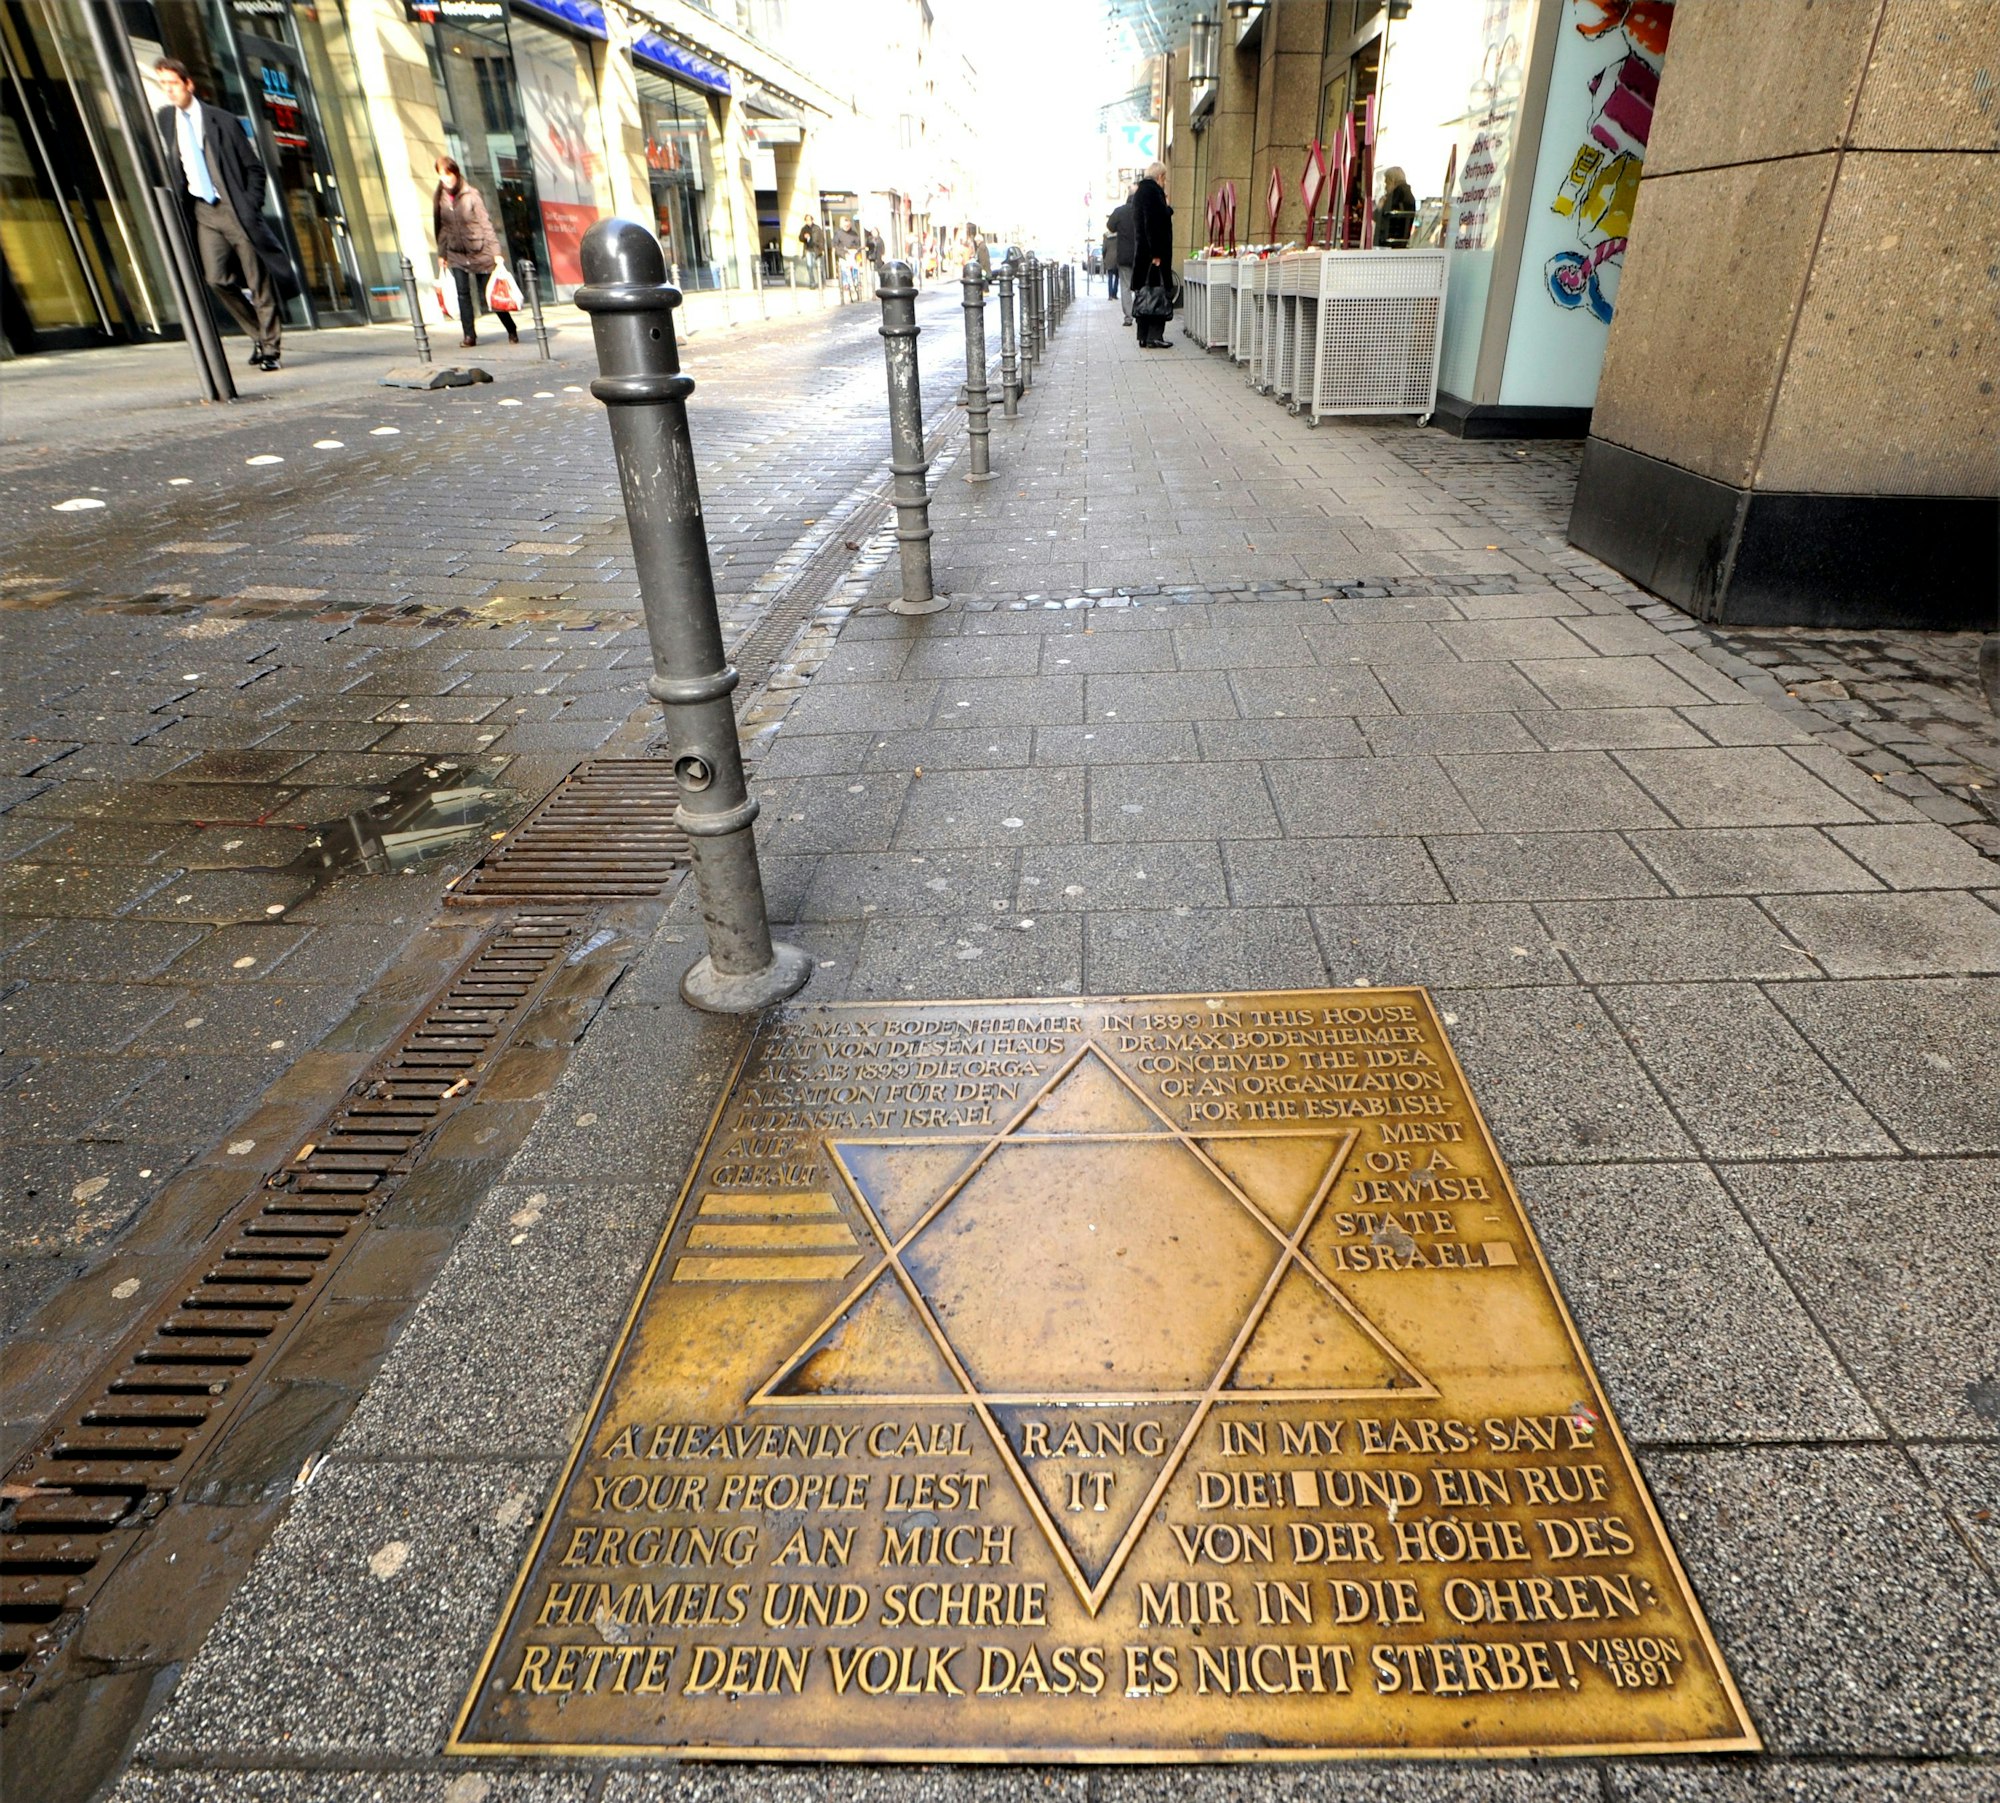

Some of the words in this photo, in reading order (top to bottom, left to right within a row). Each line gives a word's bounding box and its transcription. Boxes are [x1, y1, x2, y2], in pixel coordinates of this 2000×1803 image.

[883, 1016, 1082, 1037] BODENHEIMER
[1101, 1014, 1134, 1033] IN
[1140, 1013, 1203, 1031] 1899
[1209, 1011, 1243, 1029] IN
[1251, 1009, 1315, 1027] THIS
[1323, 1006, 1418, 1025] HOUSE
[760, 1040, 815, 1061] HAT
[822, 1040, 882, 1060] VON
[886, 1038, 986, 1059] DIESEM
[992, 1036, 1065, 1055] HAUS
[1231, 1026, 1426, 1050] BODENHEIMER
[808, 1063, 850, 1082] AB
[855, 1062, 909, 1081] 1899
[914, 1060, 960, 1080] DIE
[962, 1059, 1048, 1078] ORGA-
[1137, 1052, 1291, 1074] CONCEIVED
[1299, 1050, 1359, 1070] THE
[1364, 1048, 1437, 1068] IDEA
[743, 1085, 879, 1108] NISATION
[885, 1081, 946, 1104] FÜR
[953, 1081, 1019, 1101] DEN
[1160, 1078, 1196, 1098] OF
[1196, 1076, 1239, 1097] AN
[1242, 1070, 1446, 1096] ORGANIZATION
[730, 1108, 896, 1132] JUDENSTAAT
[901, 1104, 996, 1129] ISRAEL
[1188, 1101, 1243, 1122] FOR
[1245, 1099, 1300, 1121] THE
[1304, 1094, 1453, 1120] ESTABLISH-
[1379, 1121, 1464, 1144] MENT
[722, 1136, 807, 1159] AUF-
[1364, 1150, 1412, 1173] OF
[1427, 1149, 1459, 1171] A
[711, 1163, 818, 1187] GEBAUT
[1351, 1176, 1491, 1205] JEWISH
[1334, 1209, 1457, 1237] STATE
[1330, 1242, 1484, 1272] ISRAEL
[602, 1424, 639, 1460] A
[645, 1423, 862, 1460] HEAVENLY
[866, 1422, 974, 1458] CALL
[1021, 1421, 1168, 1459] RANG
[1219, 1420, 1267, 1456] IN
[1277, 1419, 1346, 1455] MY
[1356, 1418, 1479, 1454] EARS:
[1484, 1415, 1595, 1452] SAVE
[590, 1474, 708, 1513] YOUR
[715, 1473, 871, 1513] PEOPLE
[883, 1473, 990, 1512] LEST
[1065, 1471, 1116, 1511] IT
[1197, 1470, 1286, 1509] DIE!
[1322, 1469, 1424, 1508] UND
[1431, 1467, 1512, 1507] EIN
[1515, 1464, 1610, 1505] RUF
[558, 1526, 758, 1567] ERGING
[770, 1526, 858, 1567] AN
[878, 1525, 1017, 1567] MICH
[1169, 1523, 1275, 1567] VON
[1288, 1521, 1386, 1566] DER
[1391, 1515, 1532, 1563] HÖHE
[1535, 1516, 1635, 1560] DES
[535, 1583, 752, 1628] HIMMELS
[761, 1583, 870, 1628] UND
[880, 1582, 1048, 1627] SCHRIE
[1138, 1580, 1241, 1627] MIR
[1253, 1580, 1314, 1625] IN
[1327, 1578, 1426, 1624] DIE
[1443, 1574, 1659, 1623] OHREN:
[1577, 1637, 1684, 1664] VISION
[509, 1645, 676, 1695] RETTE
[681, 1645, 815, 1696] DEIN
[826, 1645, 967, 1697] VOLK
[974, 1642, 1107, 1697] DASS
[1124, 1645, 1181, 1697] ES
[1192, 1644, 1356, 1696] NICHT
[1370, 1640, 1582, 1694] STERBE!
[1608, 1659, 1675, 1688] 1891
